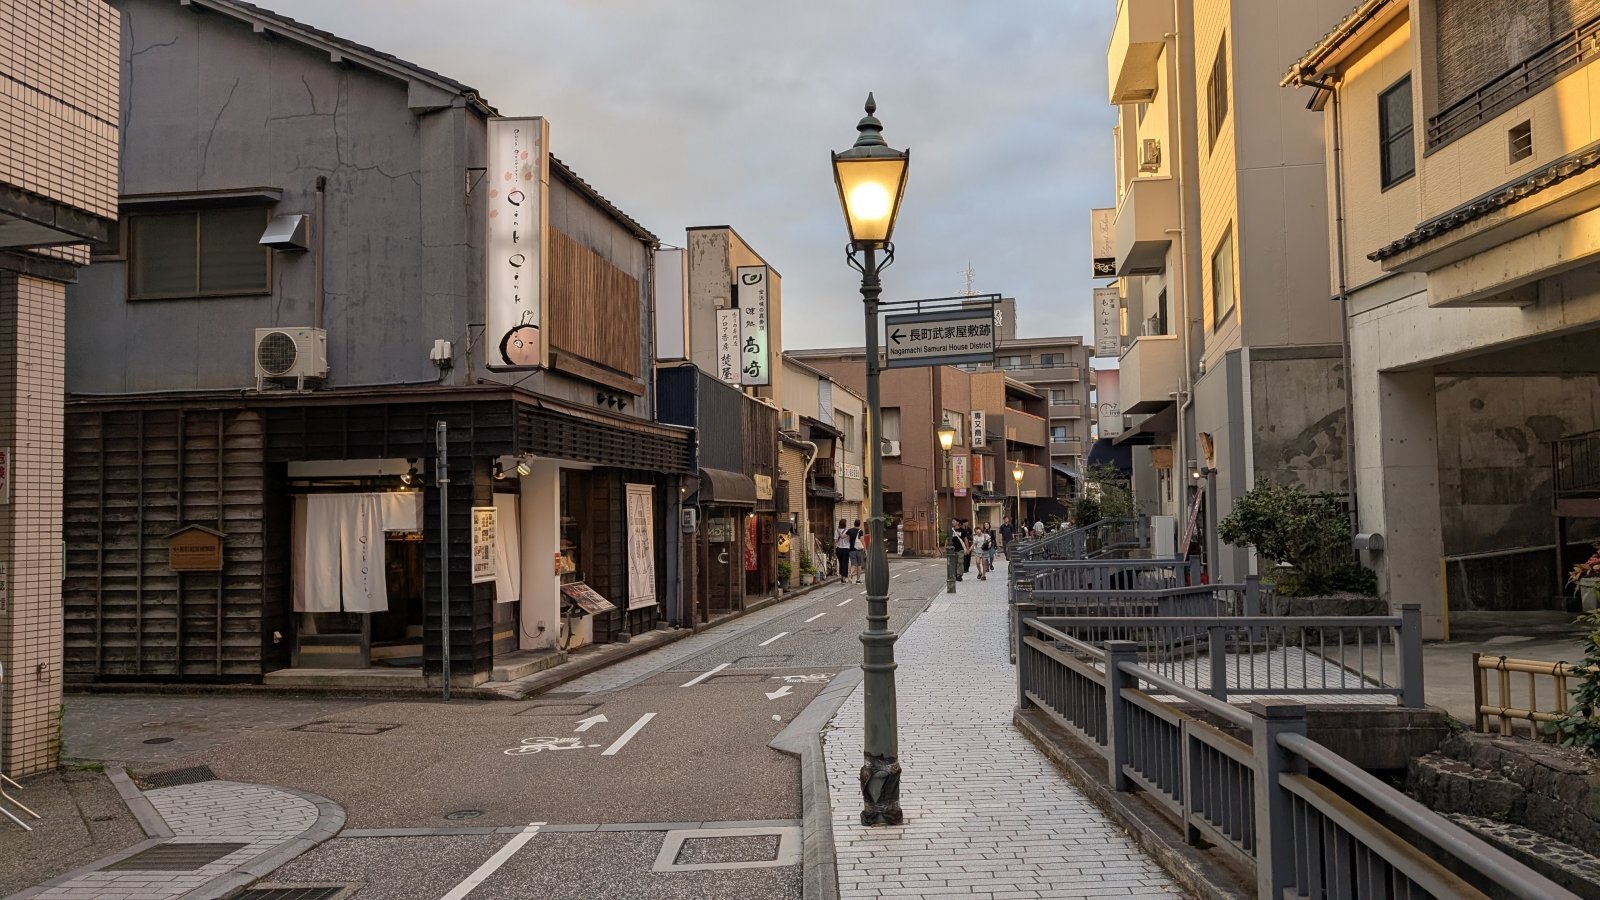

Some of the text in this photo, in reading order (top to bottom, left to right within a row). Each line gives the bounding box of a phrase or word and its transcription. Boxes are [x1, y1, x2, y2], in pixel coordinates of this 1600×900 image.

[507, 190, 525, 304] Oink Oink
[909, 323, 992, 341] 長町武家屋敷跡
[890, 341, 992, 356] Nagamachi Samurai House District
